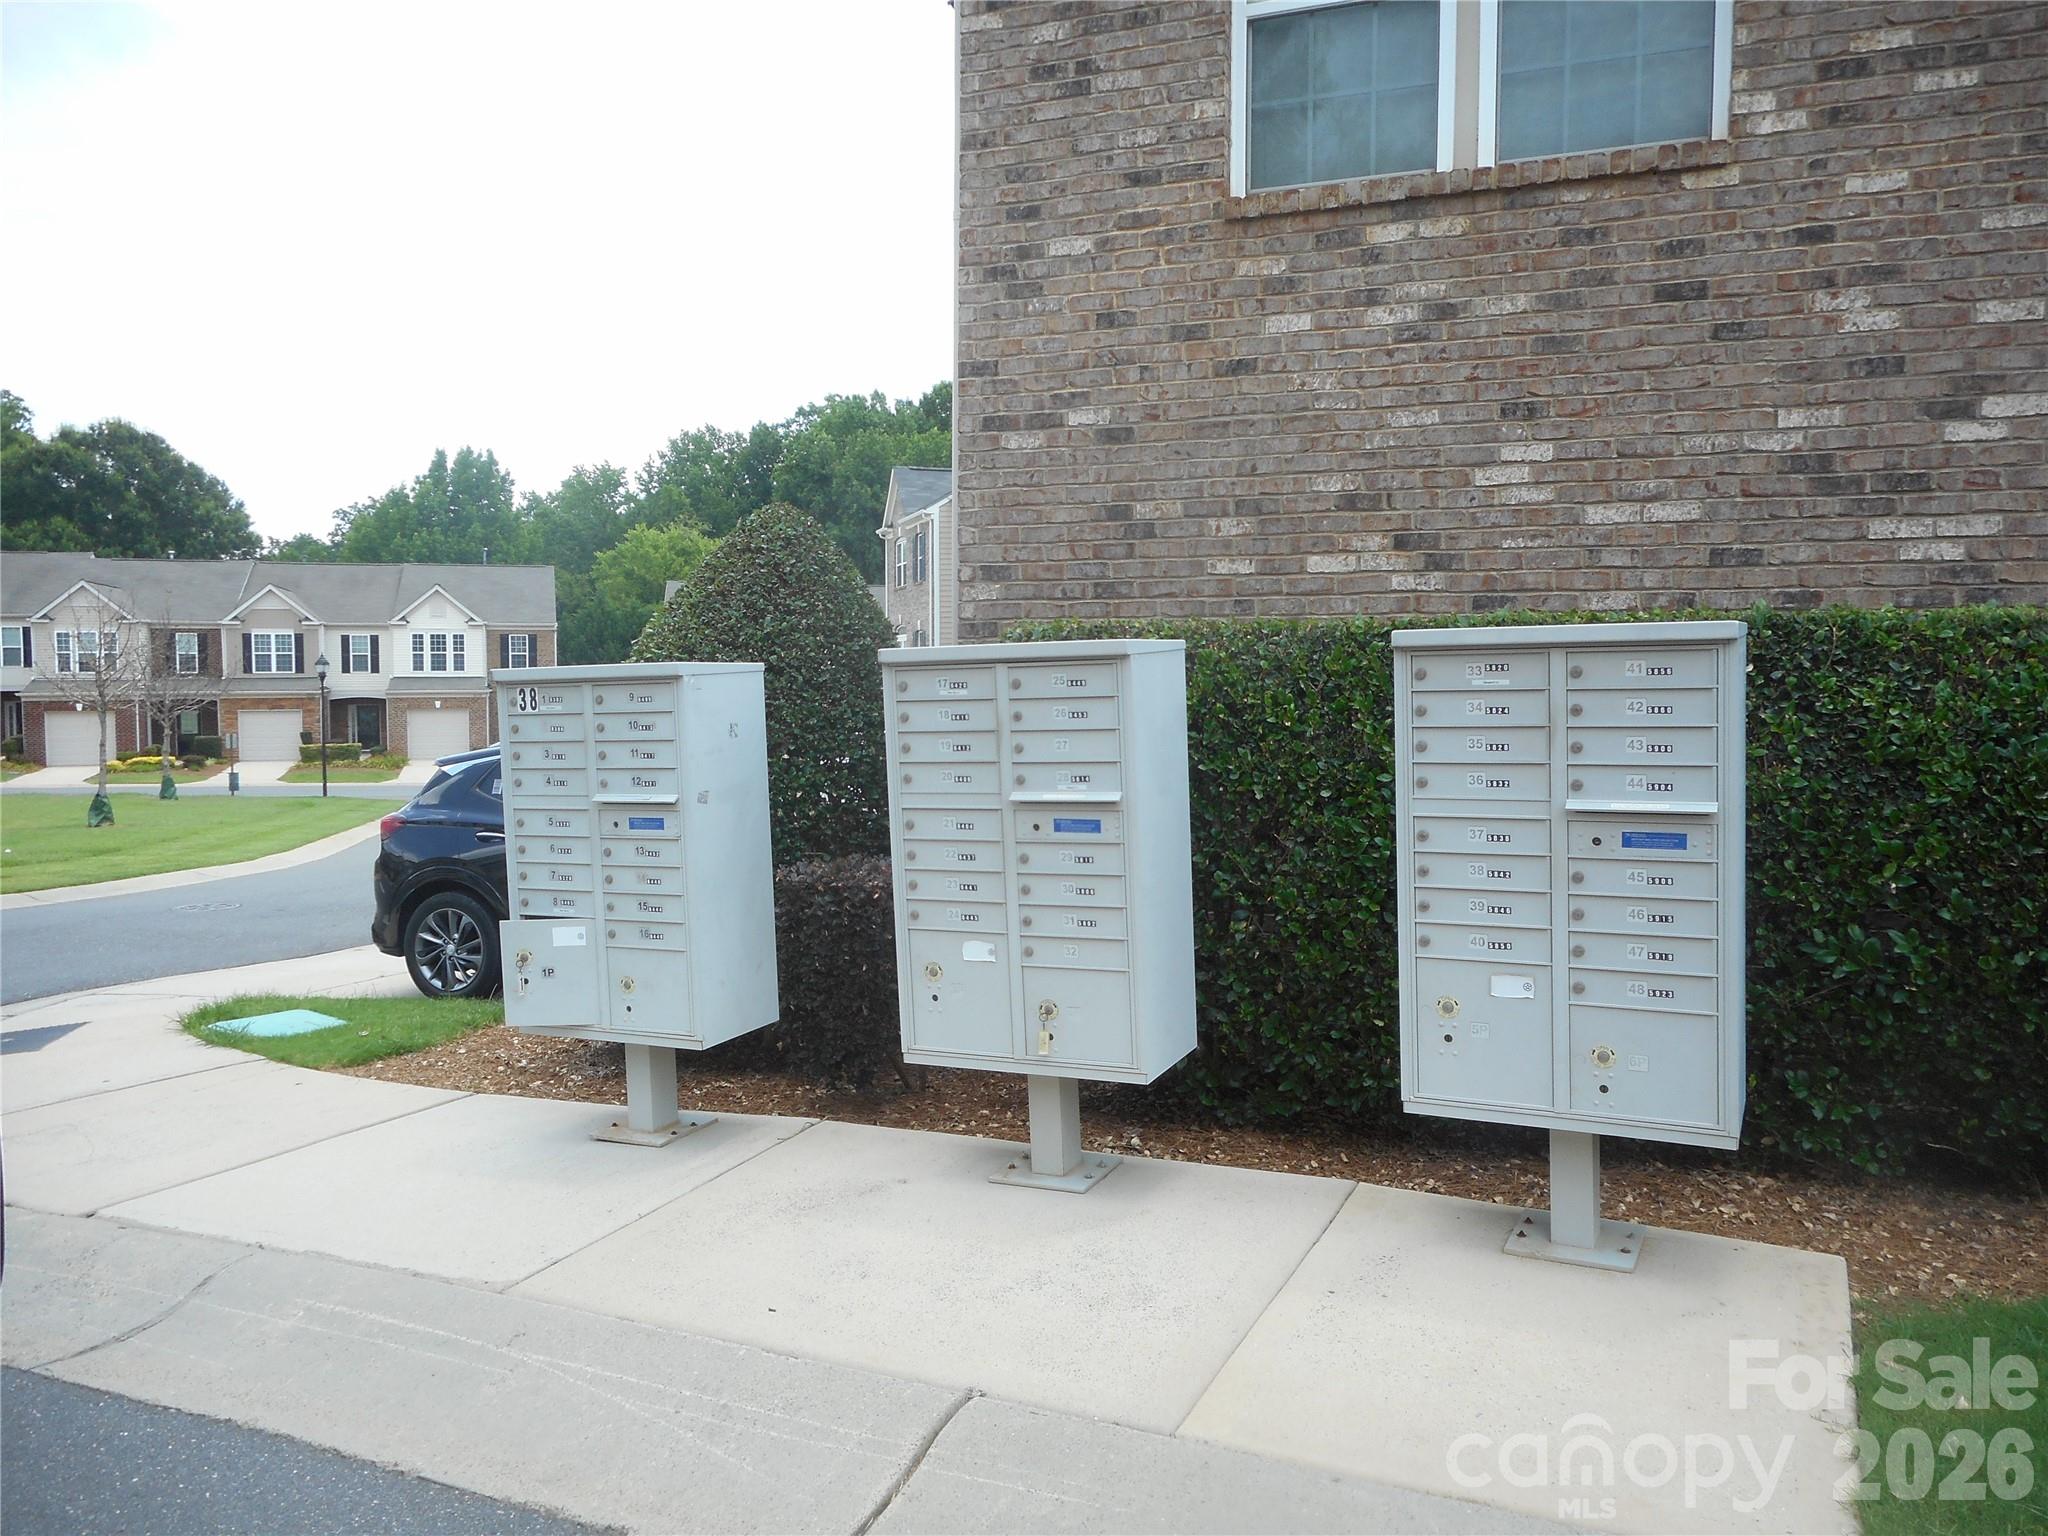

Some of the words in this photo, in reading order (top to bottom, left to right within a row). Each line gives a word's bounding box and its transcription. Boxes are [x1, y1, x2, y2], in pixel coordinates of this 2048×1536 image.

[1467, 666, 1482, 676] 33
[1627, 664, 1642, 674] 41
[937, 679, 948, 688] 17
[1053, 676, 1065, 685] 25
[519, 688, 537, 711] 38
[629, 692, 634, 702] 9
[1467, 703, 1482, 712] 34
[1627, 701, 1643, 712] 42
[938, 710, 950, 720] 18
[1055, 708, 1066, 718] 26
[629, 720, 638, 730] 10
[940, 741, 951, 750] 19
[1056, 740, 1067, 750] 27
[1468, 739, 1483, 749] 35
[1627, 740, 1643, 750] 43
[544, 749, 549, 758] 3
[630, 748, 639, 758] 11
[546, 776, 551, 785] 4
[632, 776, 641, 786] 12
[942, 772, 952, 781] 20
[1469, 775, 1483, 785] 36
[1628, 778, 1643, 788] 44
[1647, 783, 1673, 791] 5904
[548, 817, 553, 826] 5
[943, 818, 954, 828] 21
[1469, 829, 1484, 839] 37
[635, 847, 644, 857] 13
[945, 849, 957, 858] 22
[551, 870, 556, 880] 7
[1470, 865, 1484, 875] 38
[1487, 870, 1511, 878] 5842
[1628, 872, 1644, 882] 45
[1647, 877, 1673, 885] 5908
[947, 880, 958, 888] 23
[1062, 884, 1074, 893] 30
[638, 901, 648, 911] 15
[1470, 901, 1484, 911] 39
[1063, 916, 1075, 926] 31
[1629, 909, 1644, 919] 46
[1648, 915, 1673, 923] 5915
[640, 929, 649, 938] 16
[1470, 937, 1485, 947] 40
[1064, 946, 1077, 956] 32
[1628, 946, 1644, 957] 47
[1648, 952, 1673, 961] 5919
[542, 968, 554, 977] 1P
[1629, 984, 1645, 994] 48
[1648, 989, 1673, 998] 5923
[1472, 1024, 1488, 1036] 5P
